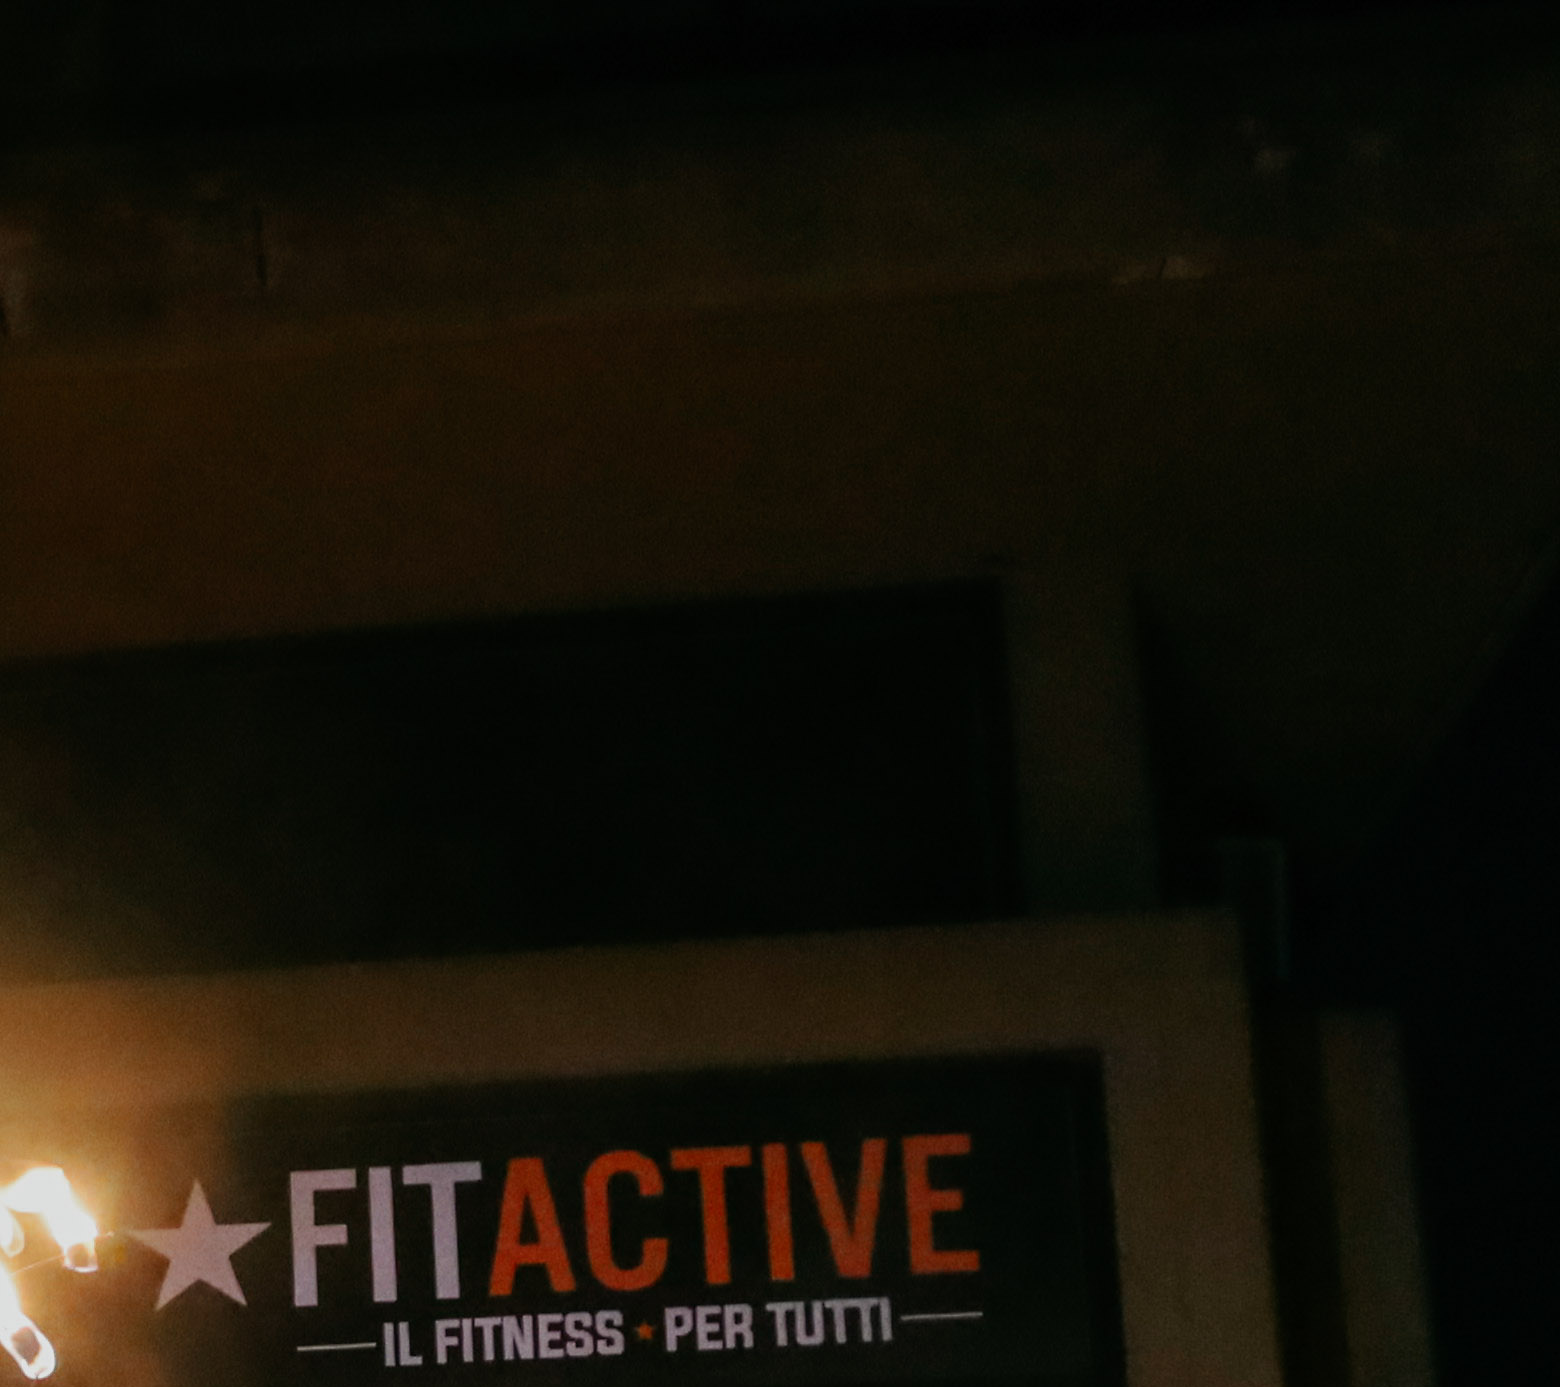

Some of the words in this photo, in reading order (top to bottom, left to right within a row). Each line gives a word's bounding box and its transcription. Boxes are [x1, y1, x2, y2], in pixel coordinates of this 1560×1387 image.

[289, 1133, 981, 1308] FITACTIVE
[383, 1322, 423, 1368] IL
[435, 1308, 625, 1364] FITNESS
[664, 1302, 754, 1353] PER
[767, 1296, 892, 1347] TUTTI
